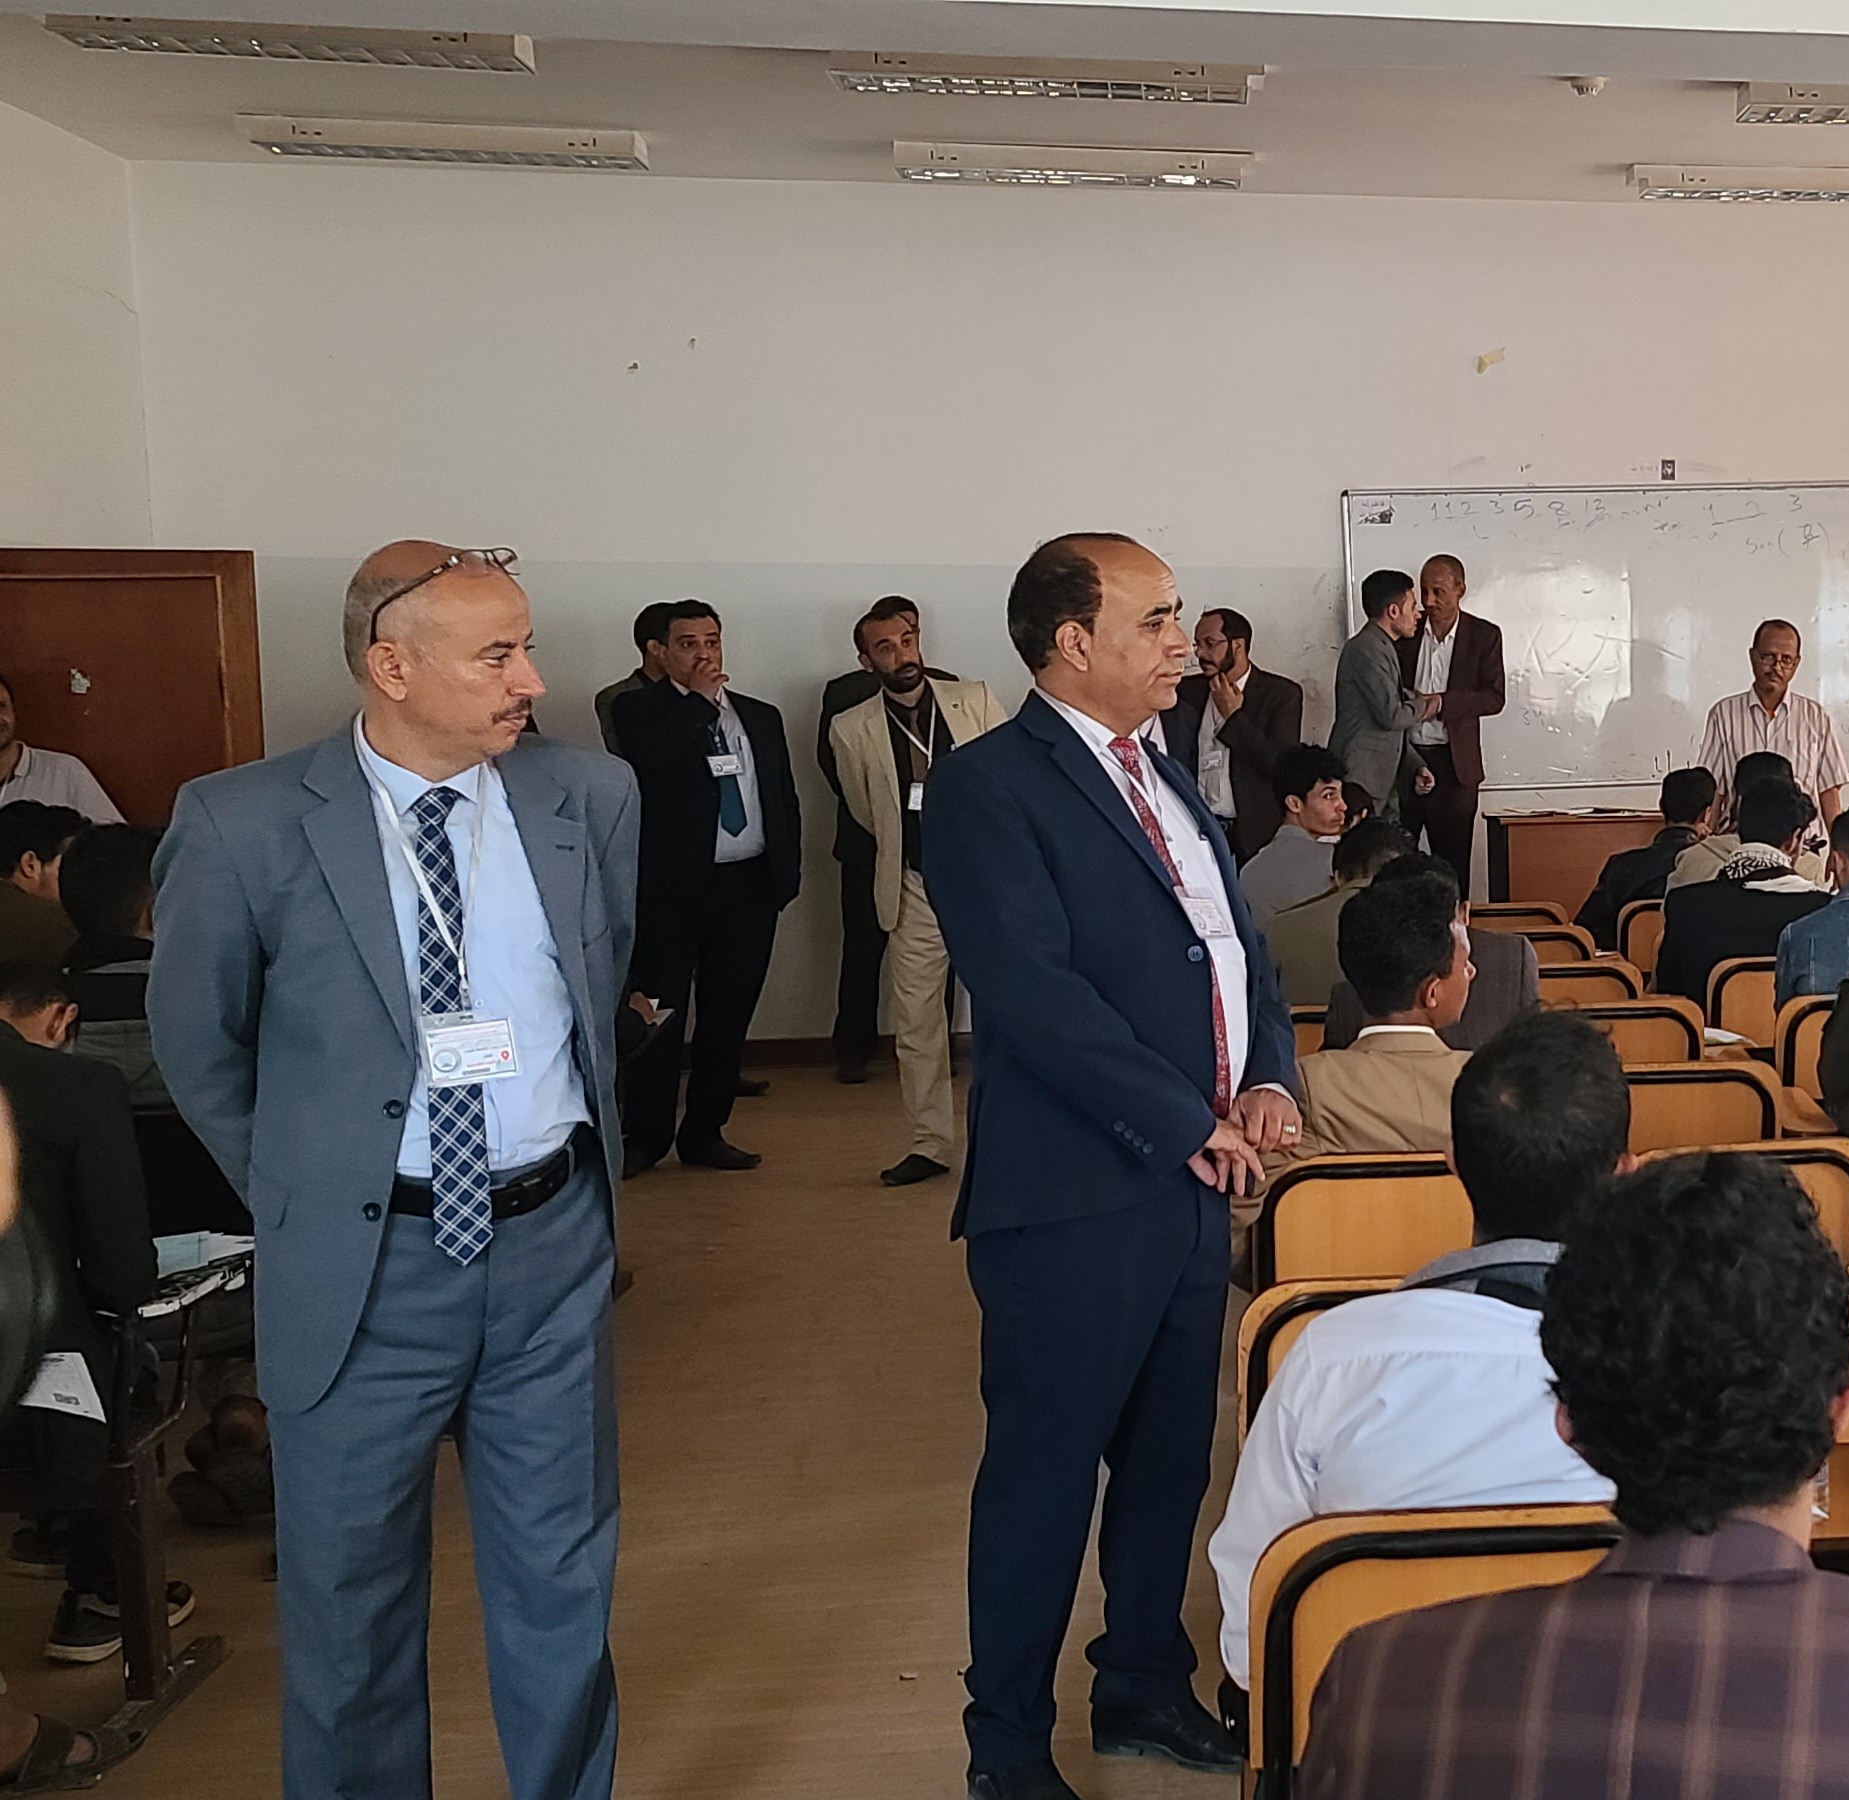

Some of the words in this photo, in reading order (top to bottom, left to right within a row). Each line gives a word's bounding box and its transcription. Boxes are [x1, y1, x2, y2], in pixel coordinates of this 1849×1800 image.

[1460, 501, 1480, 516] 2
[1489, 499, 1505, 515] 3
[1513, 498, 1535, 520] 5
[1547, 501, 1571, 517] 8
[1788, 493, 1803, 513] 3
